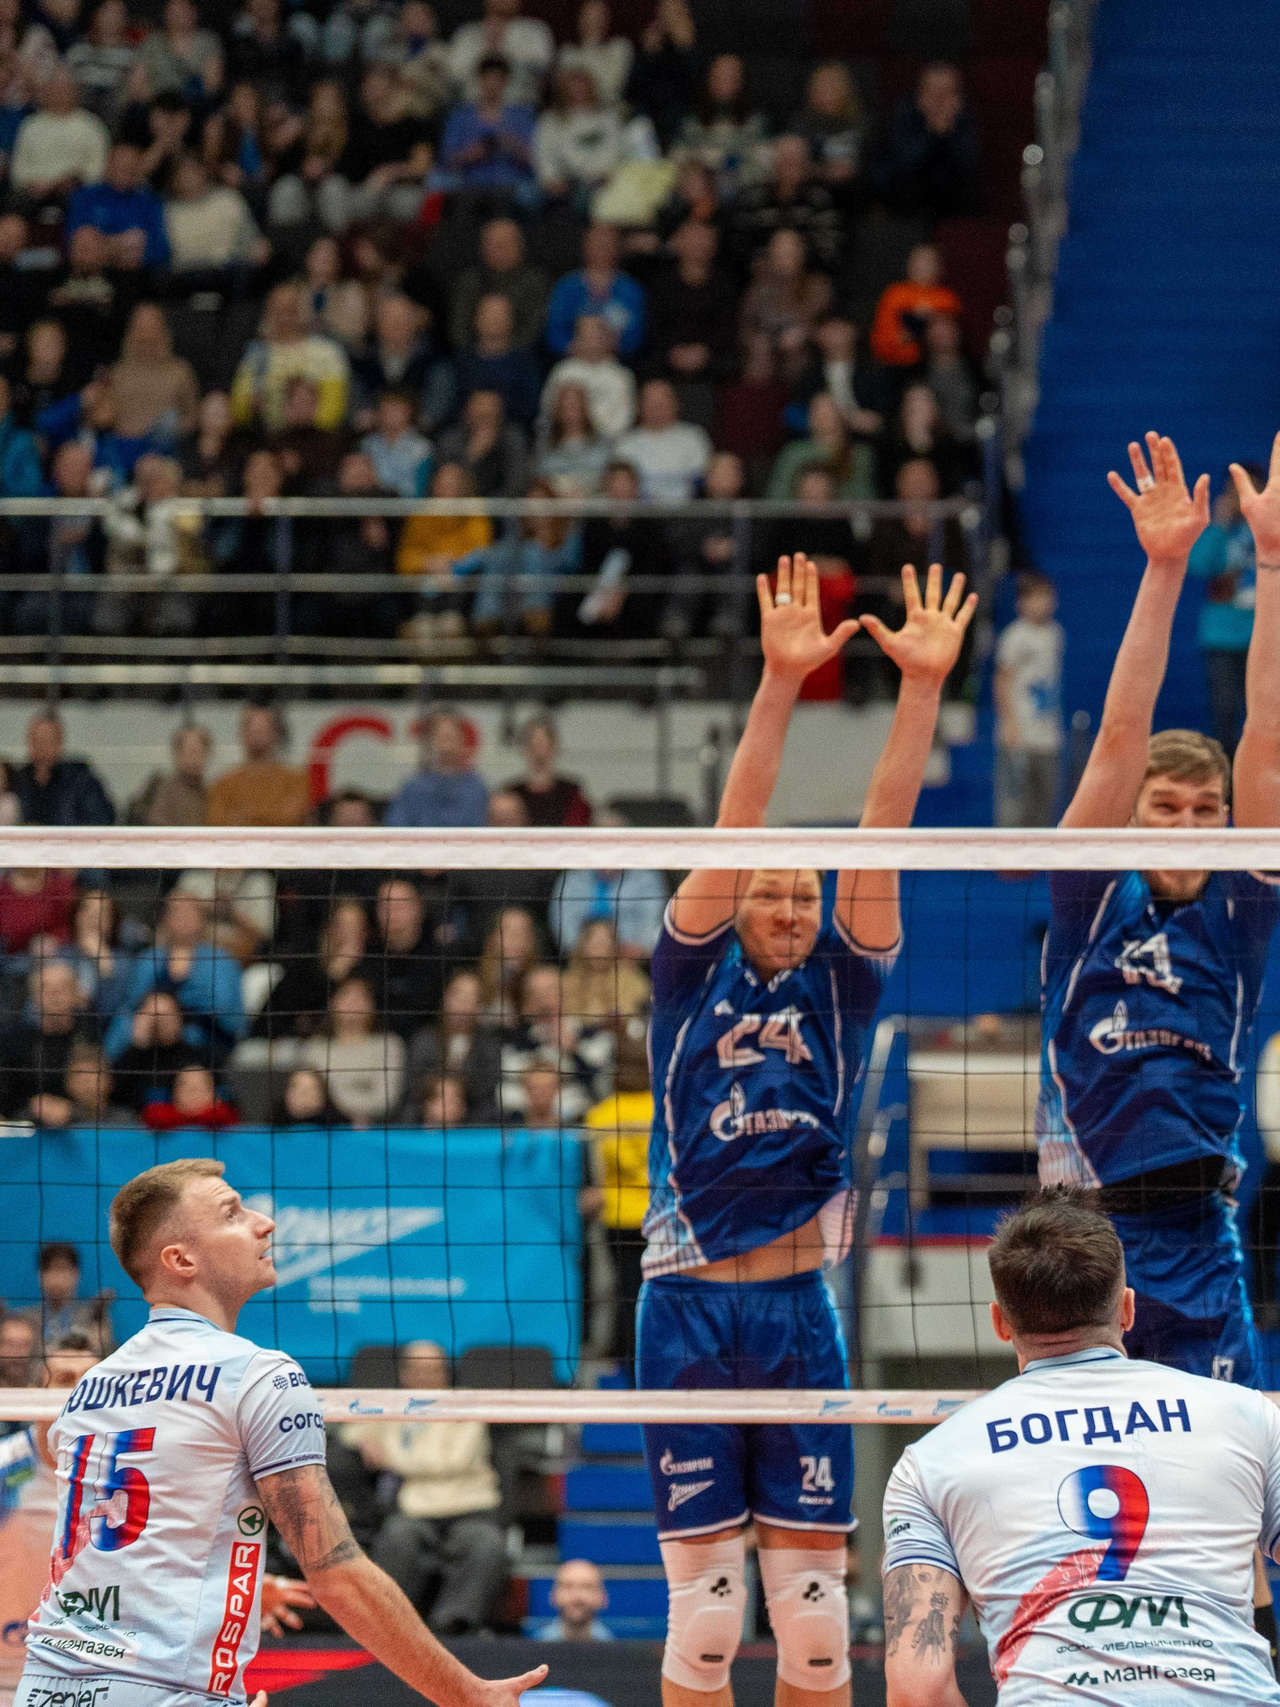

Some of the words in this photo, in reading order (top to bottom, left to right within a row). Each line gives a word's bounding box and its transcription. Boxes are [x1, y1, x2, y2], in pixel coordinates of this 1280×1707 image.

[716, 1005, 814, 1069] 24
[985, 1398, 1193, 1454] БОГДАН
[63, 1426, 157, 1560] 15
[799, 1455, 836, 1492] 24
[1057, 1464, 1150, 1582] 9
[1104, 1664, 1216, 1684] мангазея
